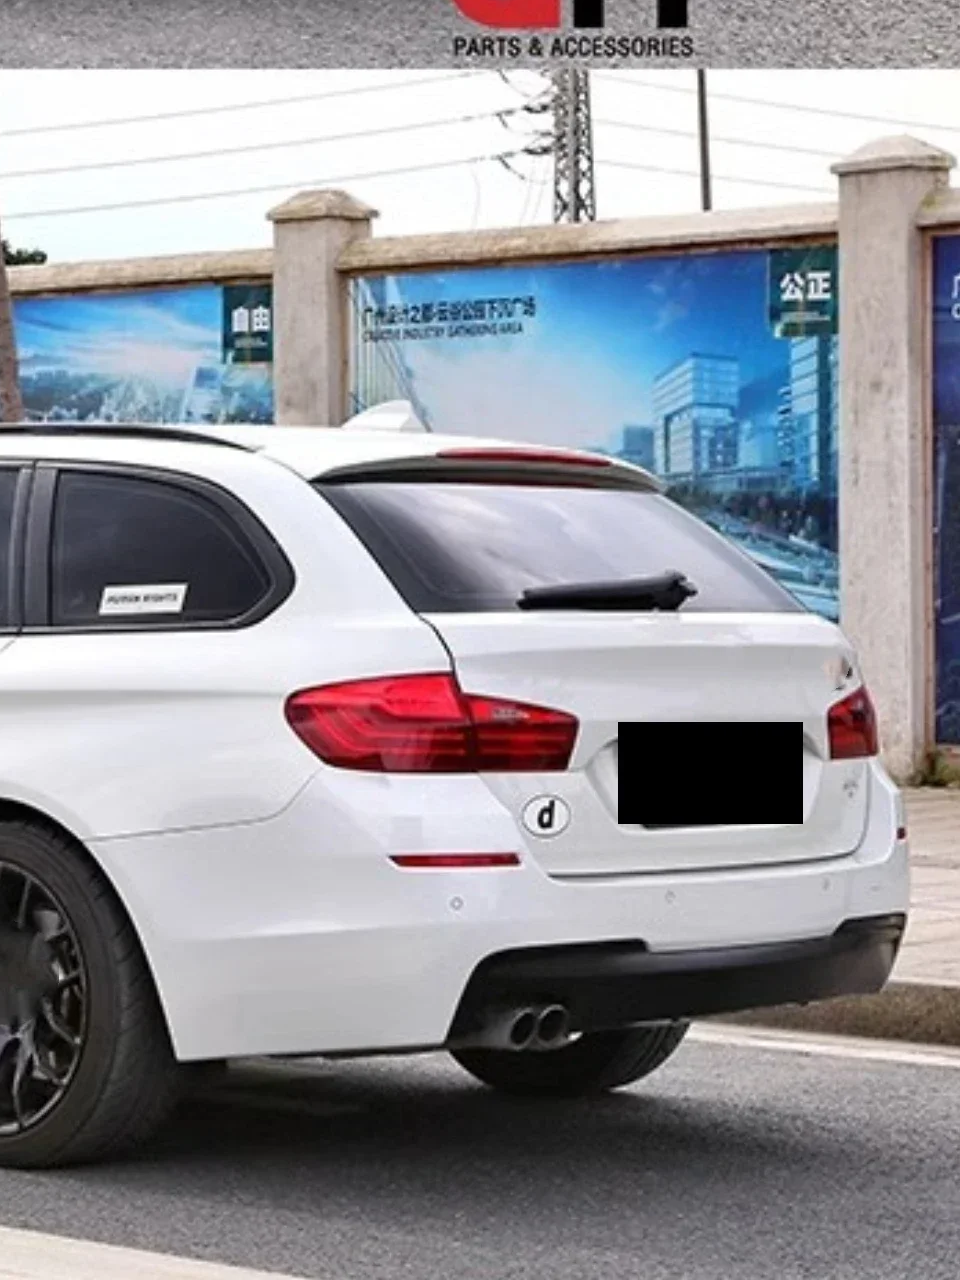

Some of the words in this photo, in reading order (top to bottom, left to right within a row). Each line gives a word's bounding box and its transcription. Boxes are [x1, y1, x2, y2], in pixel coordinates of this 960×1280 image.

[780, 272, 831, 302] 公正
[231, 305, 271, 332] 自由
[537, 799, 555, 829] d
